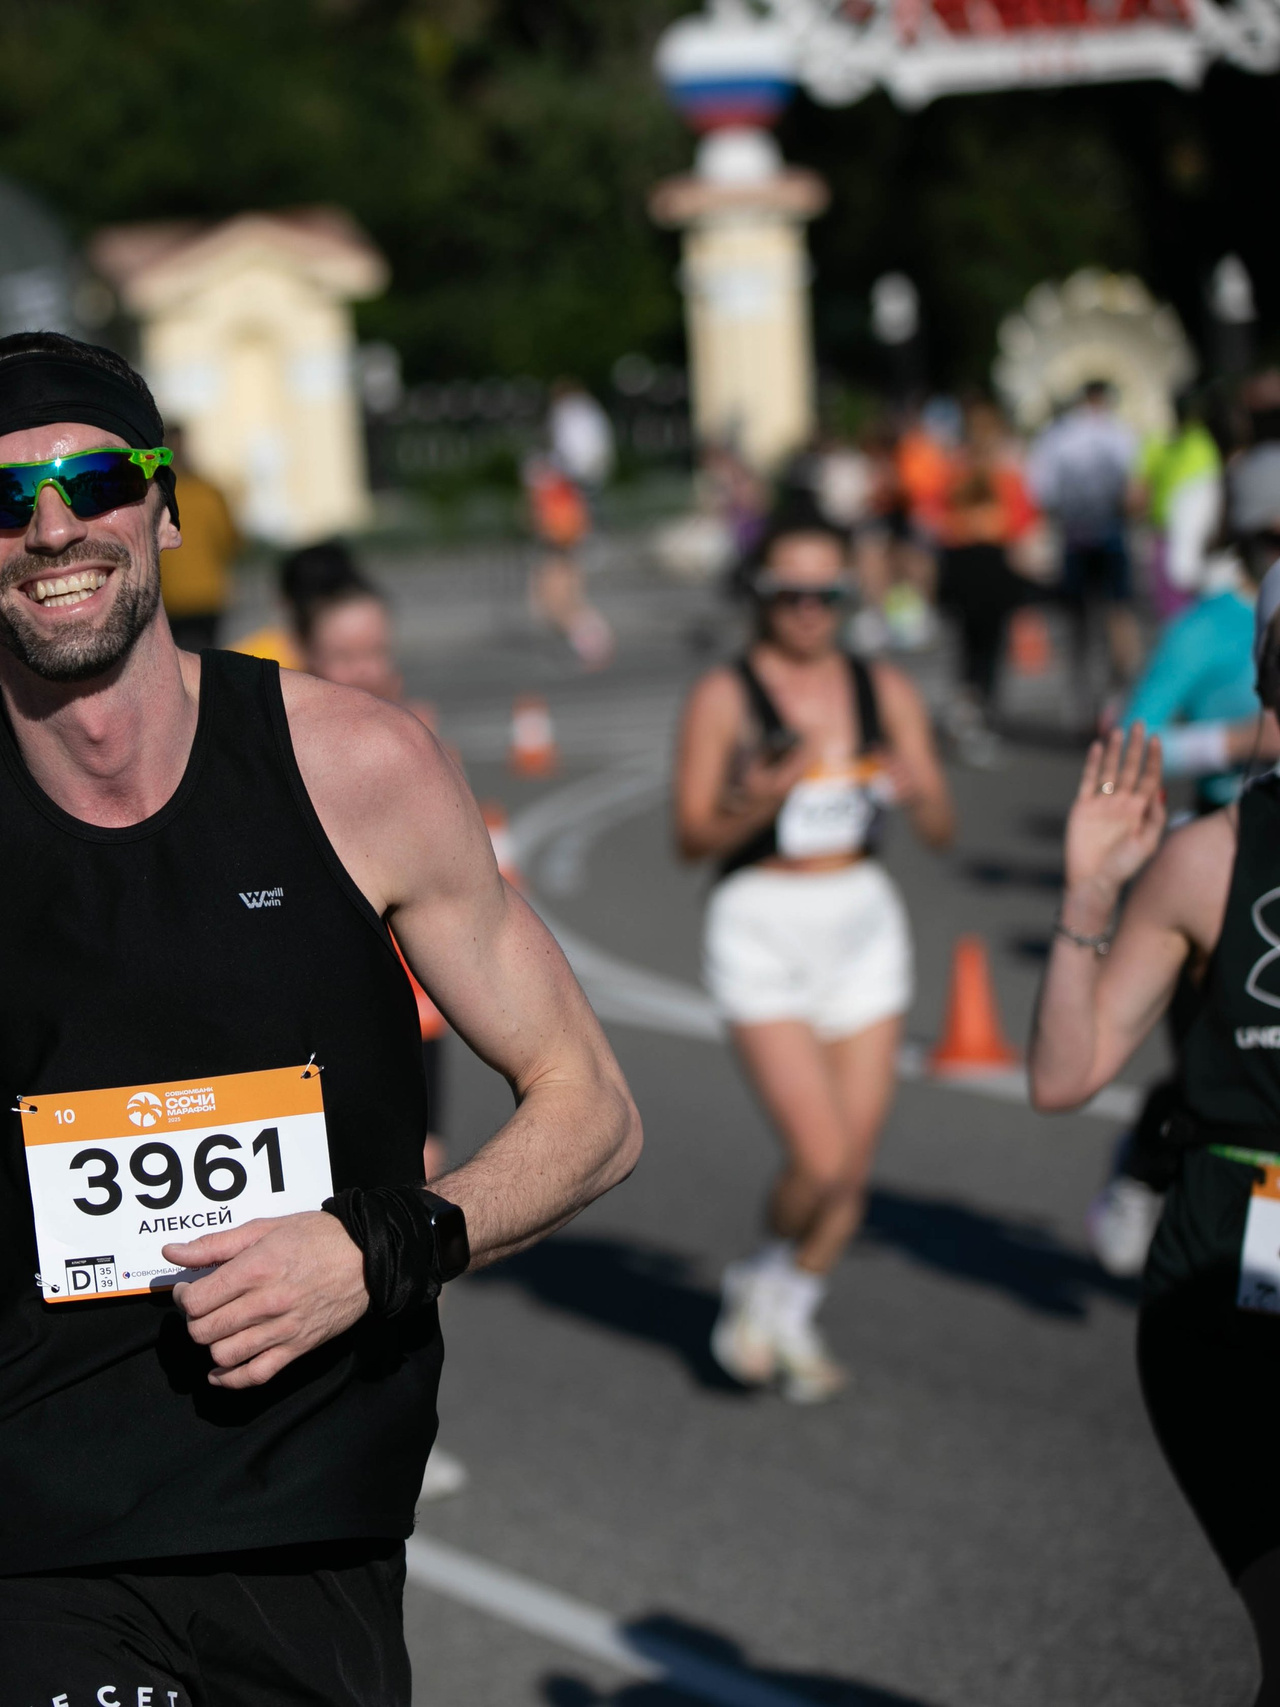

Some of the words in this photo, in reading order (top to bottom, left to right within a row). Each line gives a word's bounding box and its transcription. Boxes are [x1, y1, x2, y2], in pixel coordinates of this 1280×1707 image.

[266, 887, 284, 897] will
[263, 897, 282, 907] win
[165, 1086, 214, 1097] СОВКОМБАНК
[165, 1093, 216, 1110] СОЧИ
[167, 1104, 216, 1116] МАРАФОН
[54, 1109, 76, 1124] 10
[69, 1127, 286, 1216] 3961
[138, 1205, 233, 1235] АЛЕКСЕЙ
[99, 1267, 111, 1275] 35
[131, 1267, 183, 1278] СОВКОМБАНК
[72, 1270, 91, 1290] D
[101, 1280, 113, 1288] 39
[29, 1685, 178, 1707] ECET
